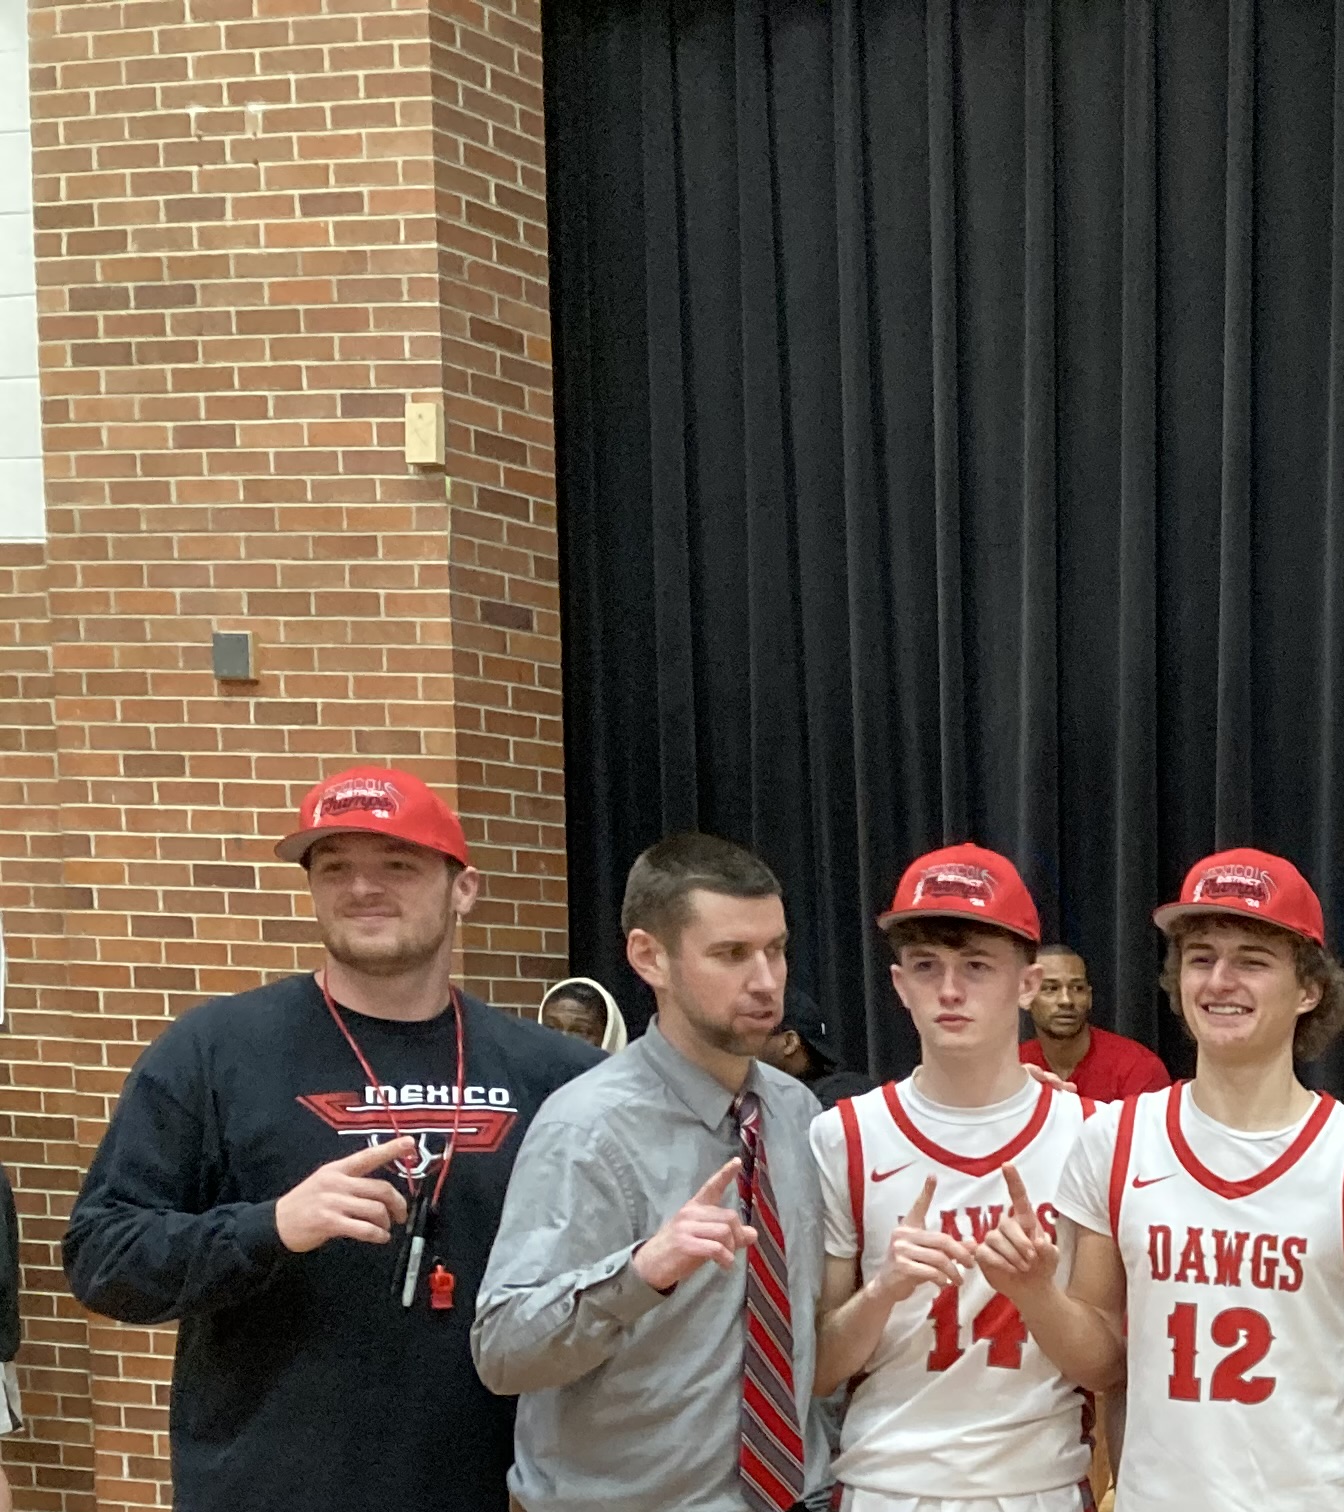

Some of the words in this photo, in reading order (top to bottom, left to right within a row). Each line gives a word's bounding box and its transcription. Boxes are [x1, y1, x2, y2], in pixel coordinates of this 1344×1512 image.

[365, 1084, 510, 1105] MEXICO
[1148, 1224, 1307, 1293] DAWGS
[927, 1278, 1028, 1372] 14
[1167, 1302, 1276, 1405] 12
